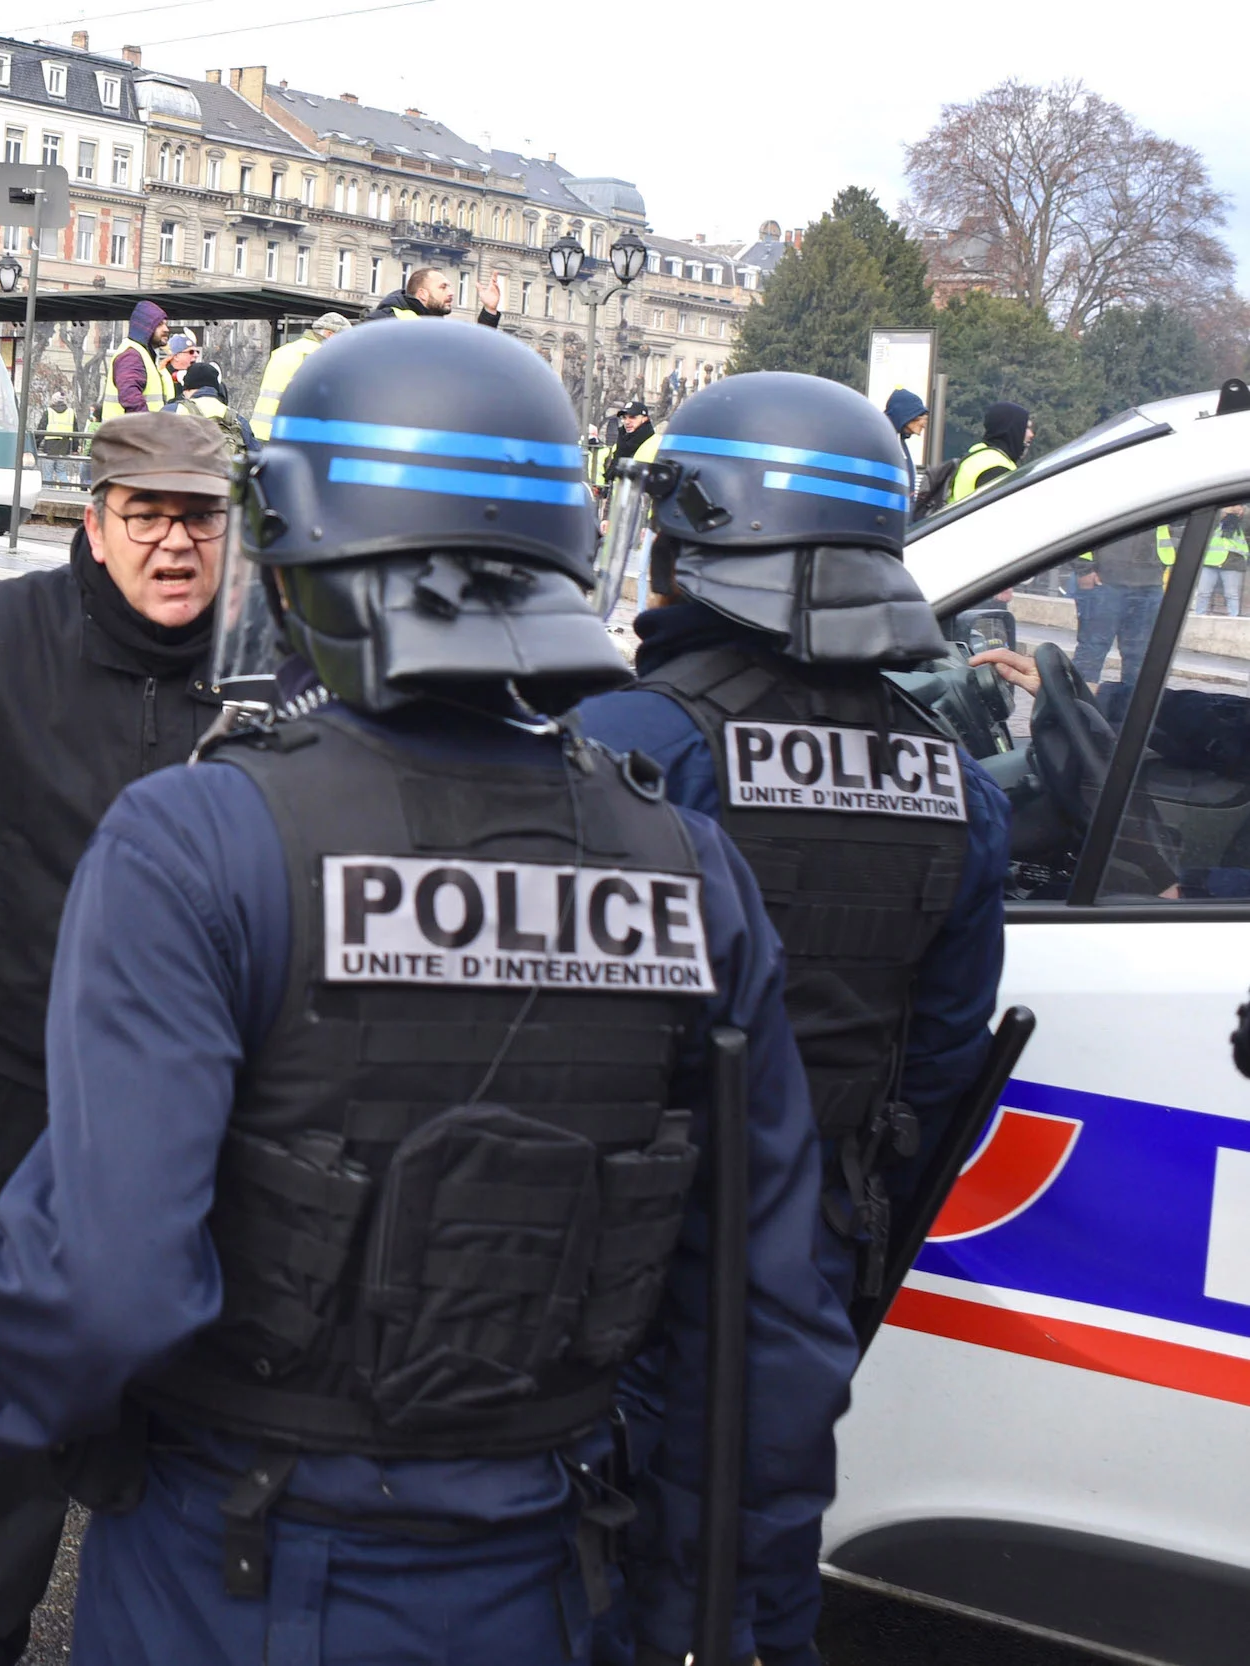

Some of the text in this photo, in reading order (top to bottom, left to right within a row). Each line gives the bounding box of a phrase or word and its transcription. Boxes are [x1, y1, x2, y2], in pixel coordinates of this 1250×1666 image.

[735, 727, 956, 798] POLICE
[740, 786, 960, 817] UNITE D'INTERVENTION
[342, 865, 696, 958] POLICE
[342, 953, 702, 987] UNITE D'INTERVENTION
